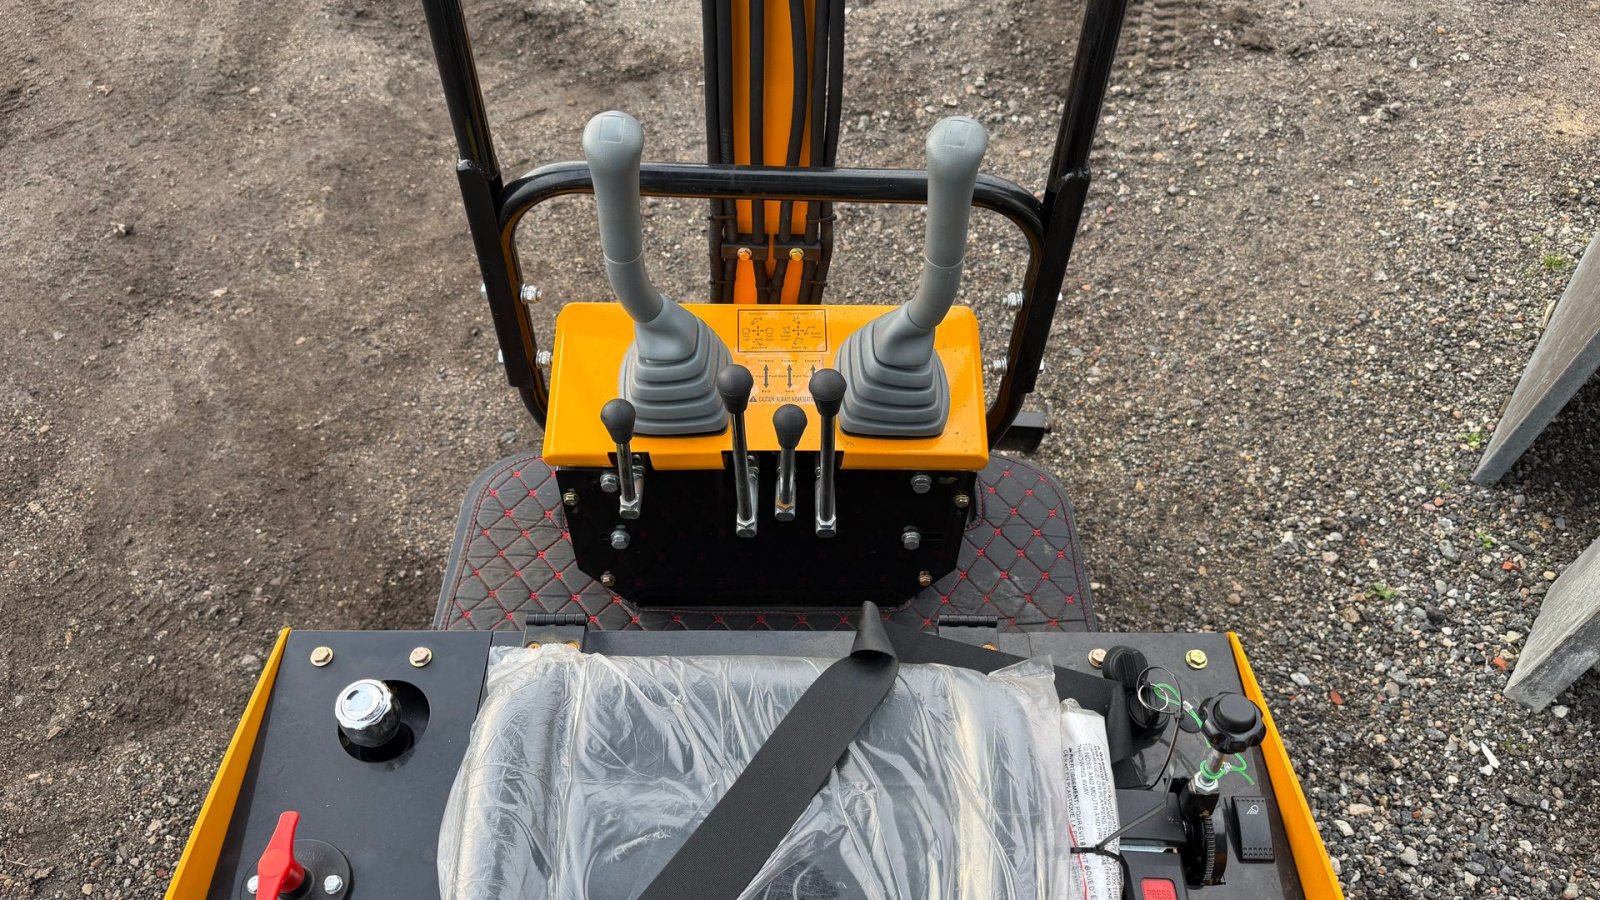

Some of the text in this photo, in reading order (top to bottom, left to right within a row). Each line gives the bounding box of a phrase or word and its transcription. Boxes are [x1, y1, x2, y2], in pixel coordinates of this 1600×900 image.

[1084, 752, 1093, 771] NOSE
[1088, 771, 1096, 785] AND
[1090, 786, 1099, 811] MOUTH
[1146, 889, 1172, 900] PRESS
